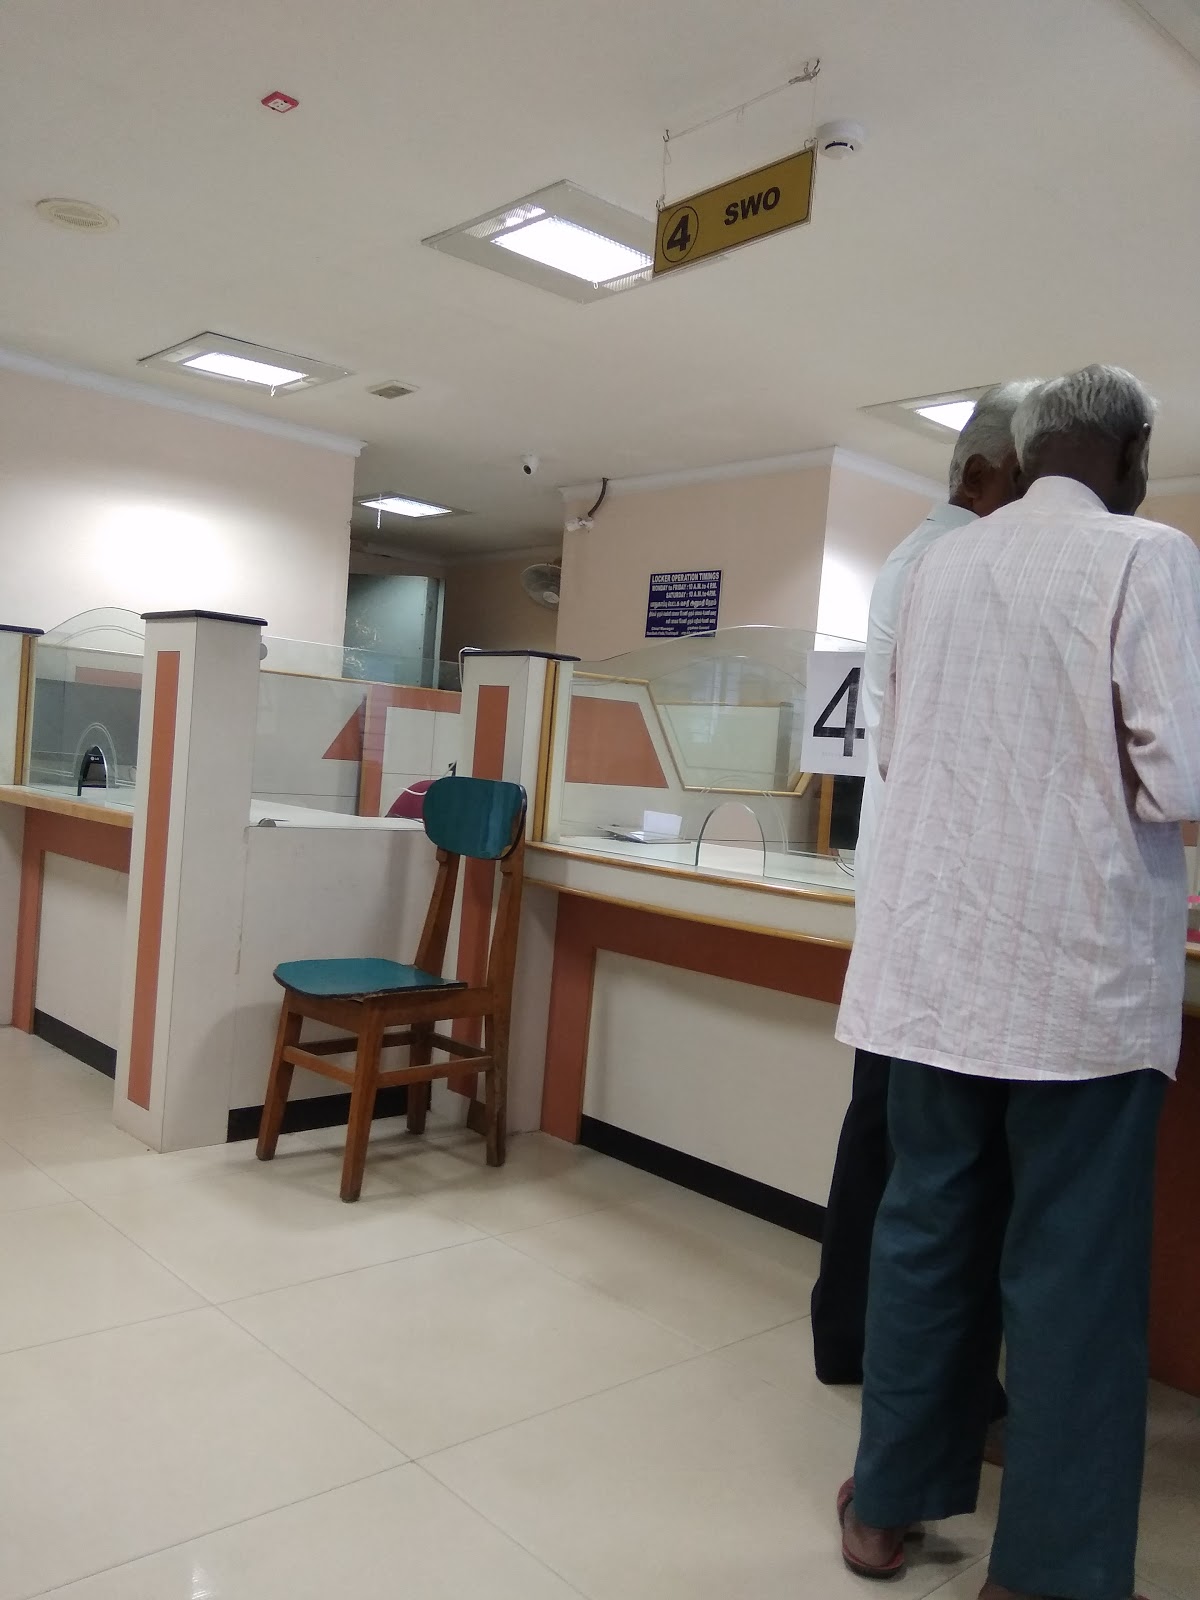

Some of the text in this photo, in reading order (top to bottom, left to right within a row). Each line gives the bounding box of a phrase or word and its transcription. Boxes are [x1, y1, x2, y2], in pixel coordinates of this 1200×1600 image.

[667, 186, 781, 252] 4 SWO
[652, 572, 720, 582] LOCKER OPERATION TIMINGS
[812, 667, 866, 757] 4
